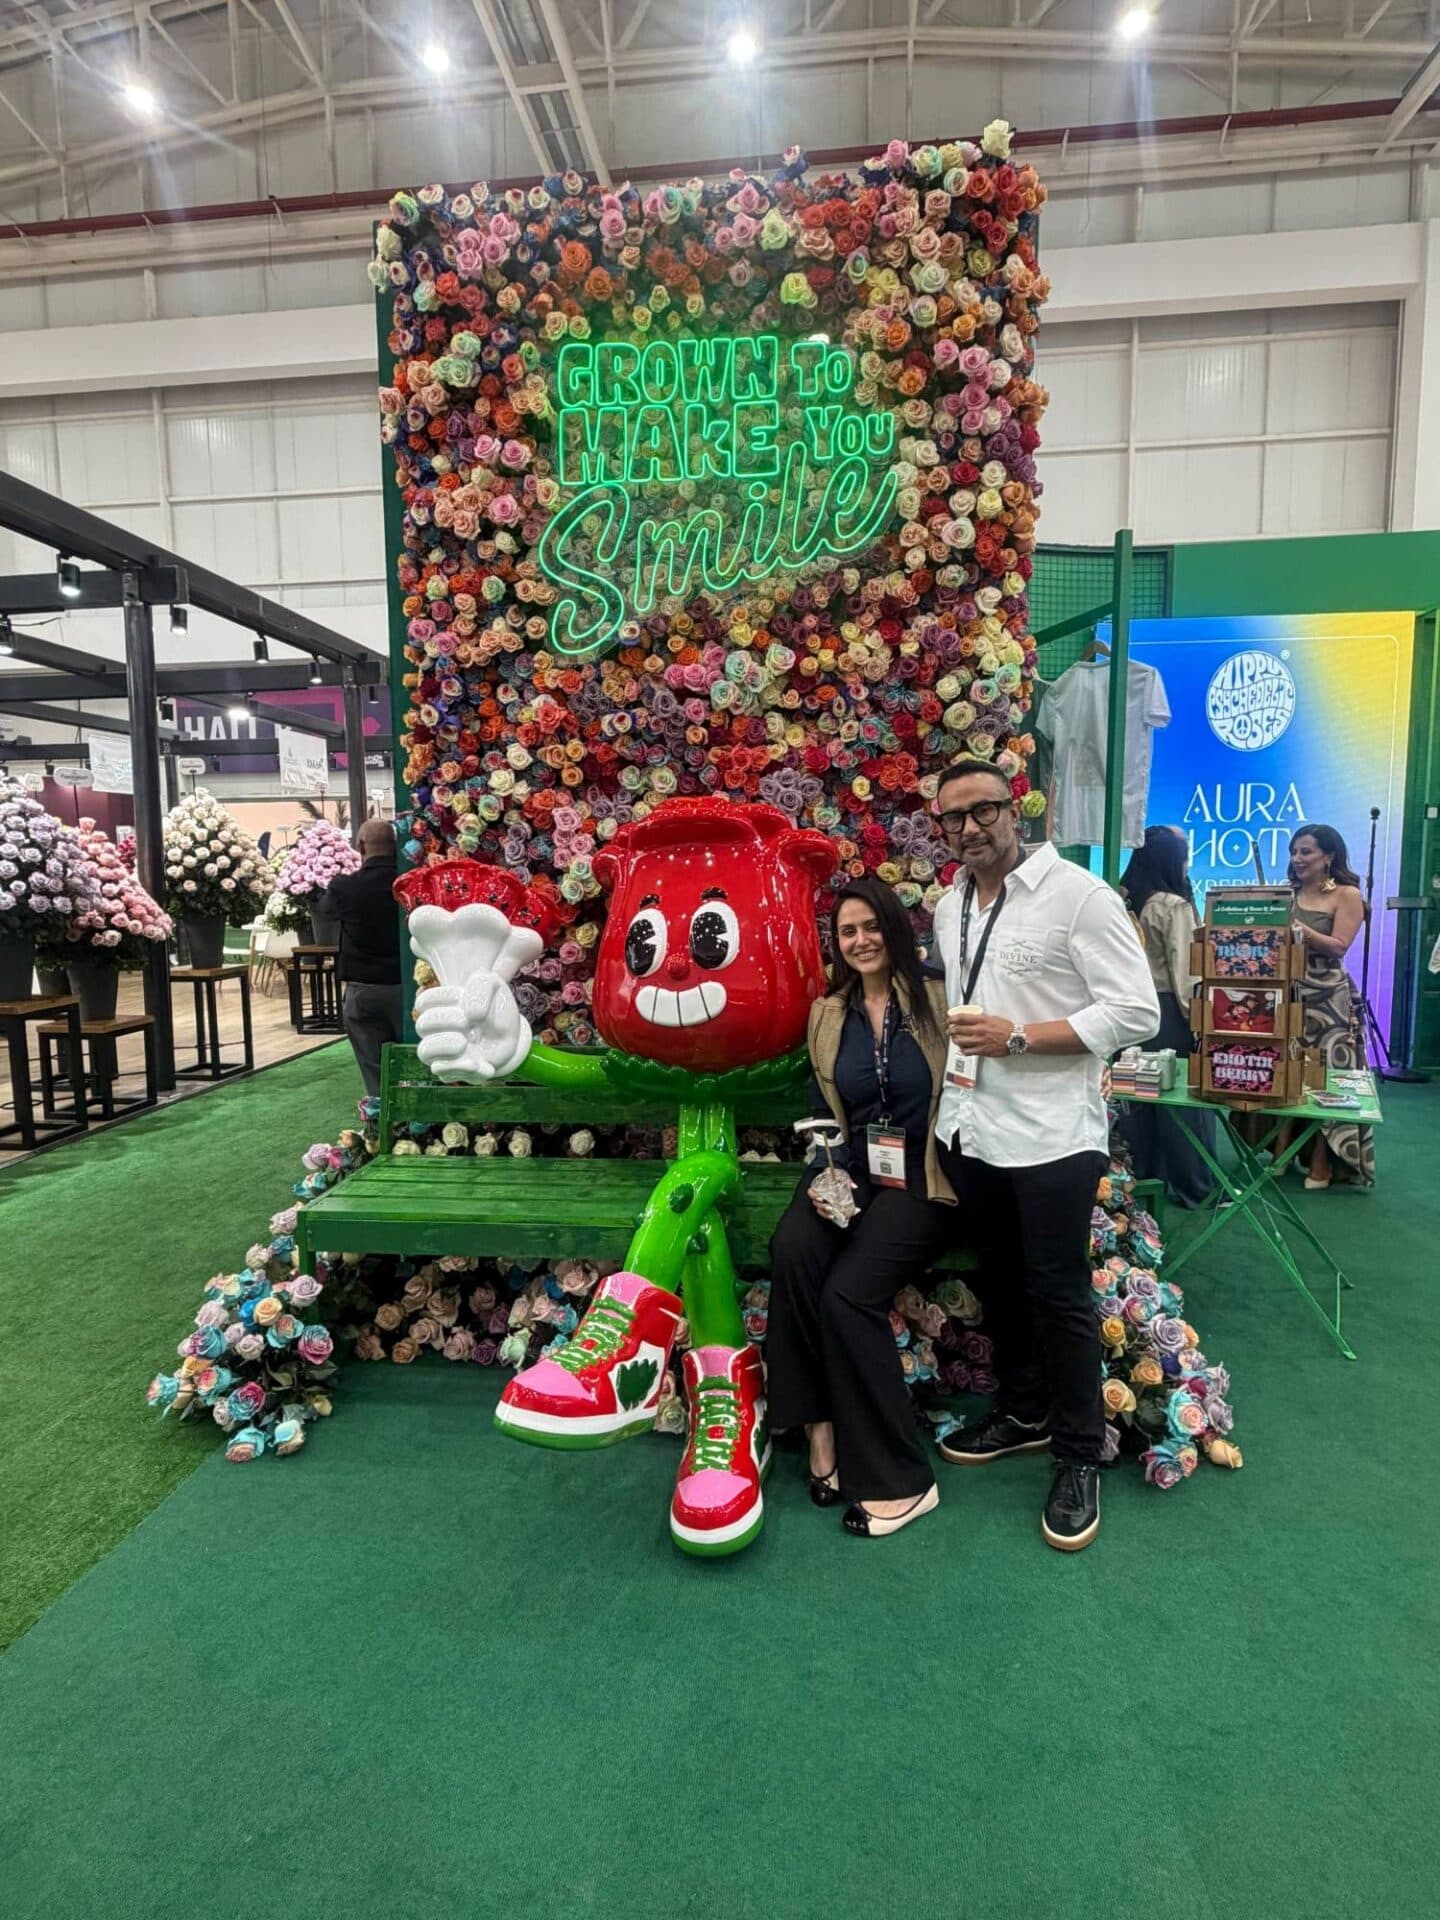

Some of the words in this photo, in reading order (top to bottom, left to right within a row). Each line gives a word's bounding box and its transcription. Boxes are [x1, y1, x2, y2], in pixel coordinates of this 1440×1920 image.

[557, 335, 778, 407] GROWN
[792, 342, 853, 396] TO
[559, 400, 780, 485] MAKE
[805, 406, 895, 461] YOU
[538, 441, 899, 655] Smile
[1211, 652, 1290, 690] HIPPY
[1208, 677, 1295, 720] PSYCHEDELIC
[1210, 707, 1290, 750] ROSES
[1183, 782, 1308, 823] AURA
[1187, 827, 1293, 868] HOT
[1000, 951, 1038, 964] DIVINE
[1215, 1066, 1270, 1082] BERRY
